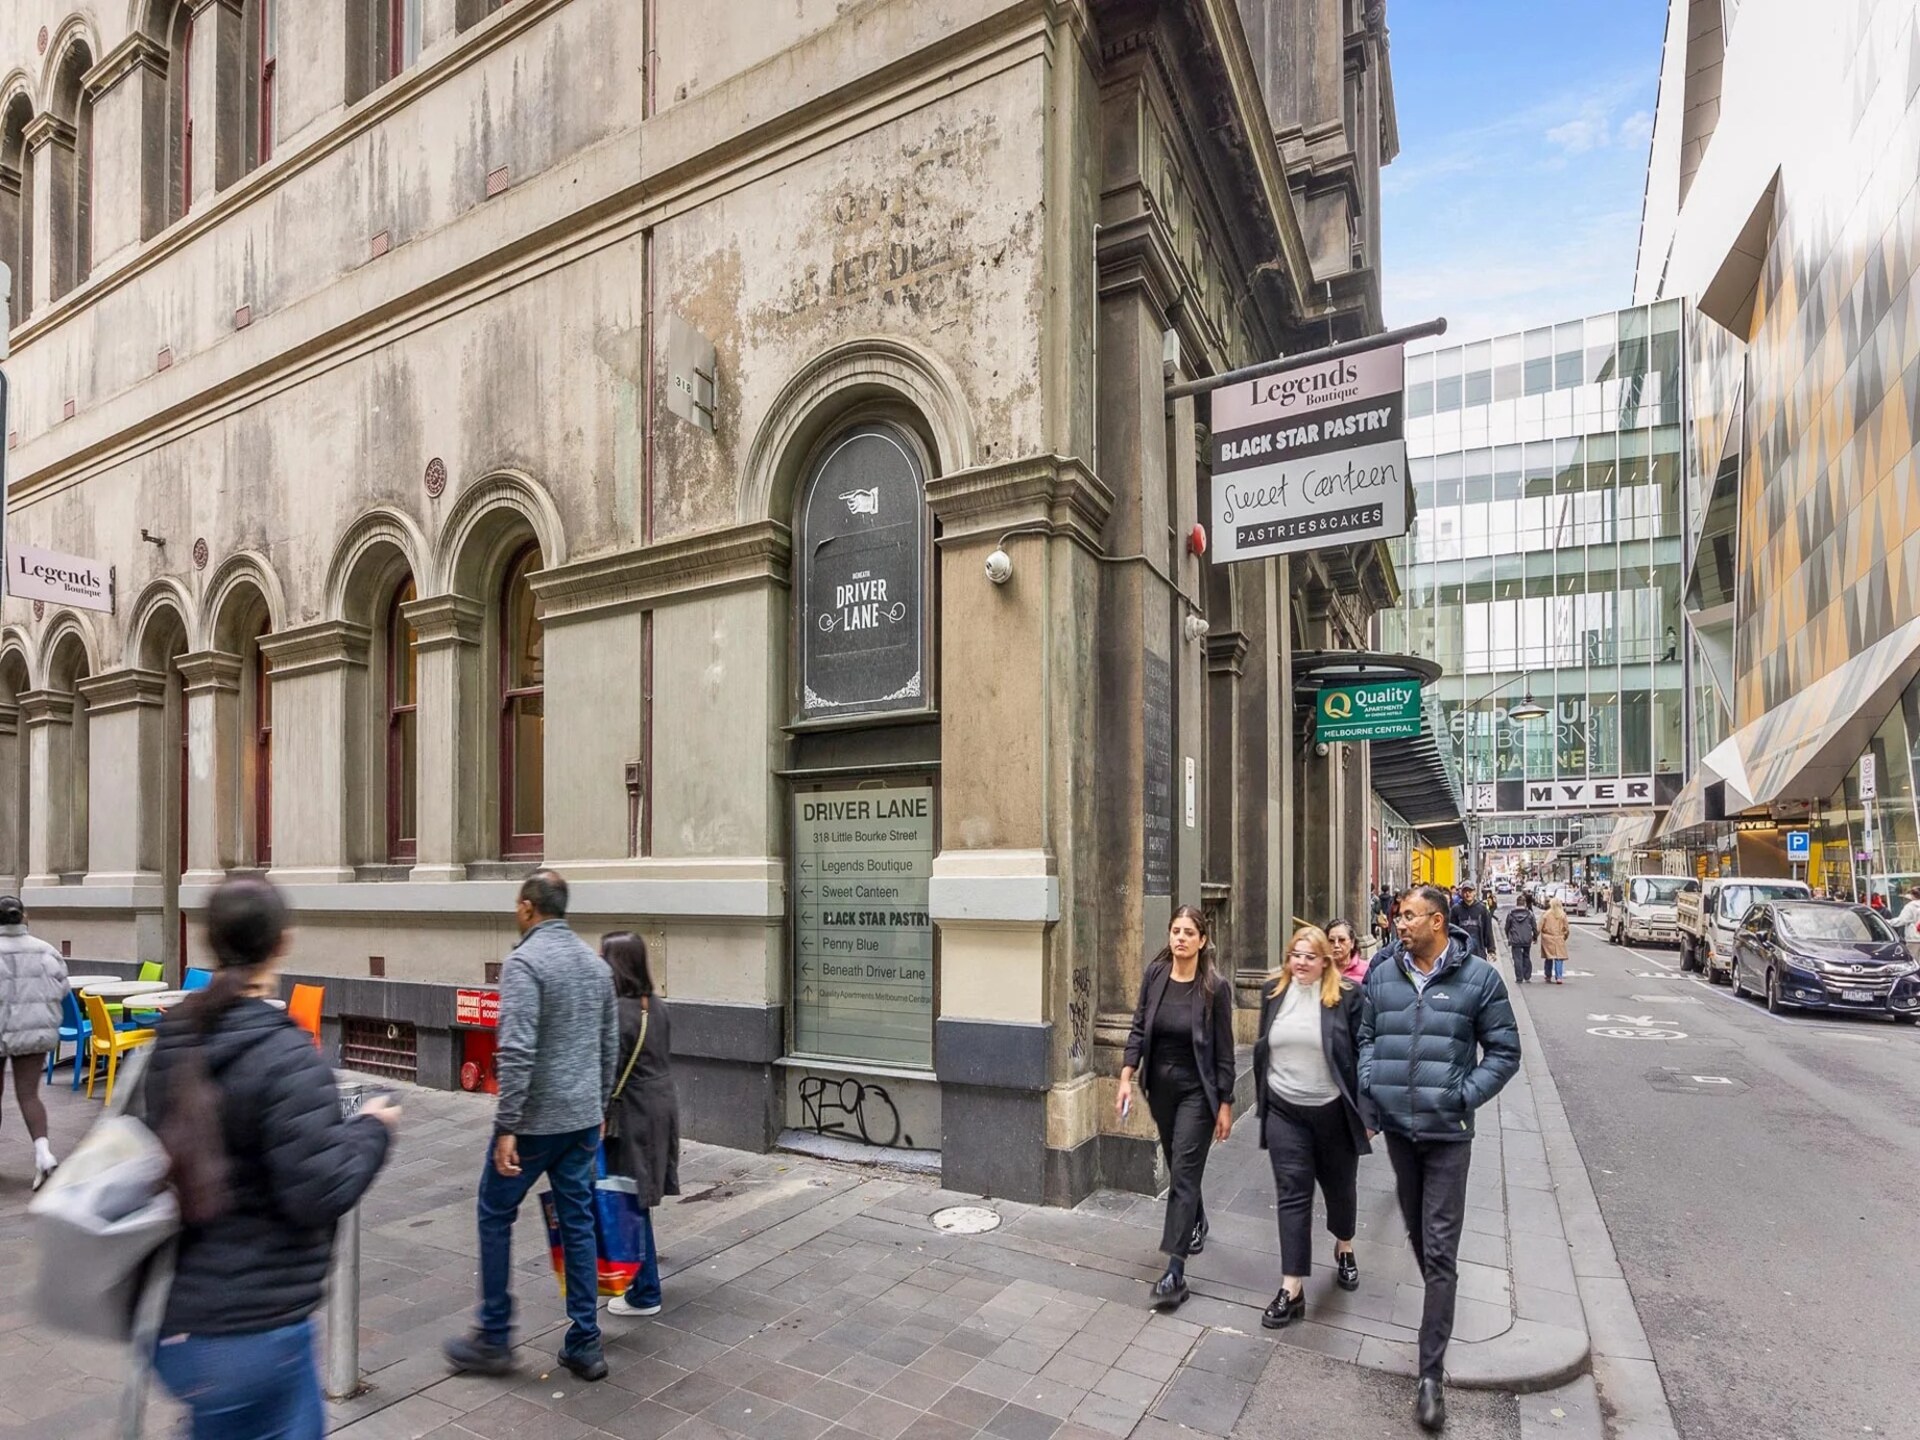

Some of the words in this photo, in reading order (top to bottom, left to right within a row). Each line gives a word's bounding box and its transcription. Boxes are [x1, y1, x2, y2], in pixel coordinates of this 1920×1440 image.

[675, 376, 692, 394] 318
[1251, 360, 1358, 406] Legends
[1306, 385, 1359, 406] Boutique
[1221, 435, 1272, 462] BLACK
[1276, 426, 1320, 449] STAR
[1324, 407, 1392, 439] PASTRY
[1223, 473, 1289, 524] Sweet
[1302, 461, 1398, 504] Canteen
[20, 556, 100, 588] Legends
[64, 583, 102, 598] Boutique
[836, 579, 887, 609] DRIVER
[843, 603, 879, 632] LANE
[1355, 688, 1413, 707] Quality
[1364, 704, 1404, 713] APARTMENTS
[1324, 728, 1373, 737] MELBOURNE
[1375, 725, 1413, 734] CENTRAL
[1530, 782, 1649, 802] MYER
[803, 800, 870, 822] DRIVER
[876, 798, 928, 819] LANE
[1734, 820, 1776, 830] MYER
[813, 832, 830, 843] 318
[831, 831, 853, 843] Little
[854, 830, 887, 842] Bourke
[889, 829, 918, 842] Street
[1483, 836, 1515, 847] DAVID
[1517, 835, 1554, 846] JONES
[1793, 836, 1804, 849] P
[822, 858, 865, 873] Legends
[867, 859, 913, 873] Boutique
[822, 886, 853, 898] Sweet
[855, 885, 899, 898] Canteen
[823, 911, 856, 927] BLACK
[858, 911, 886, 927] STAR
[889, 911, 930, 927] PASTRY
[822, 938, 853, 953] Penny
[856, 938, 879, 952] Blue
[822, 962, 864, 978] Beneath
[866, 965, 896, 980] Driver
[899, 966, 926, 981] Lane
[819, 988, 840, 1000] Quality
[840, 990, 875, 1001] Apartments
[875, 993, 908, 1002] Melbourne
